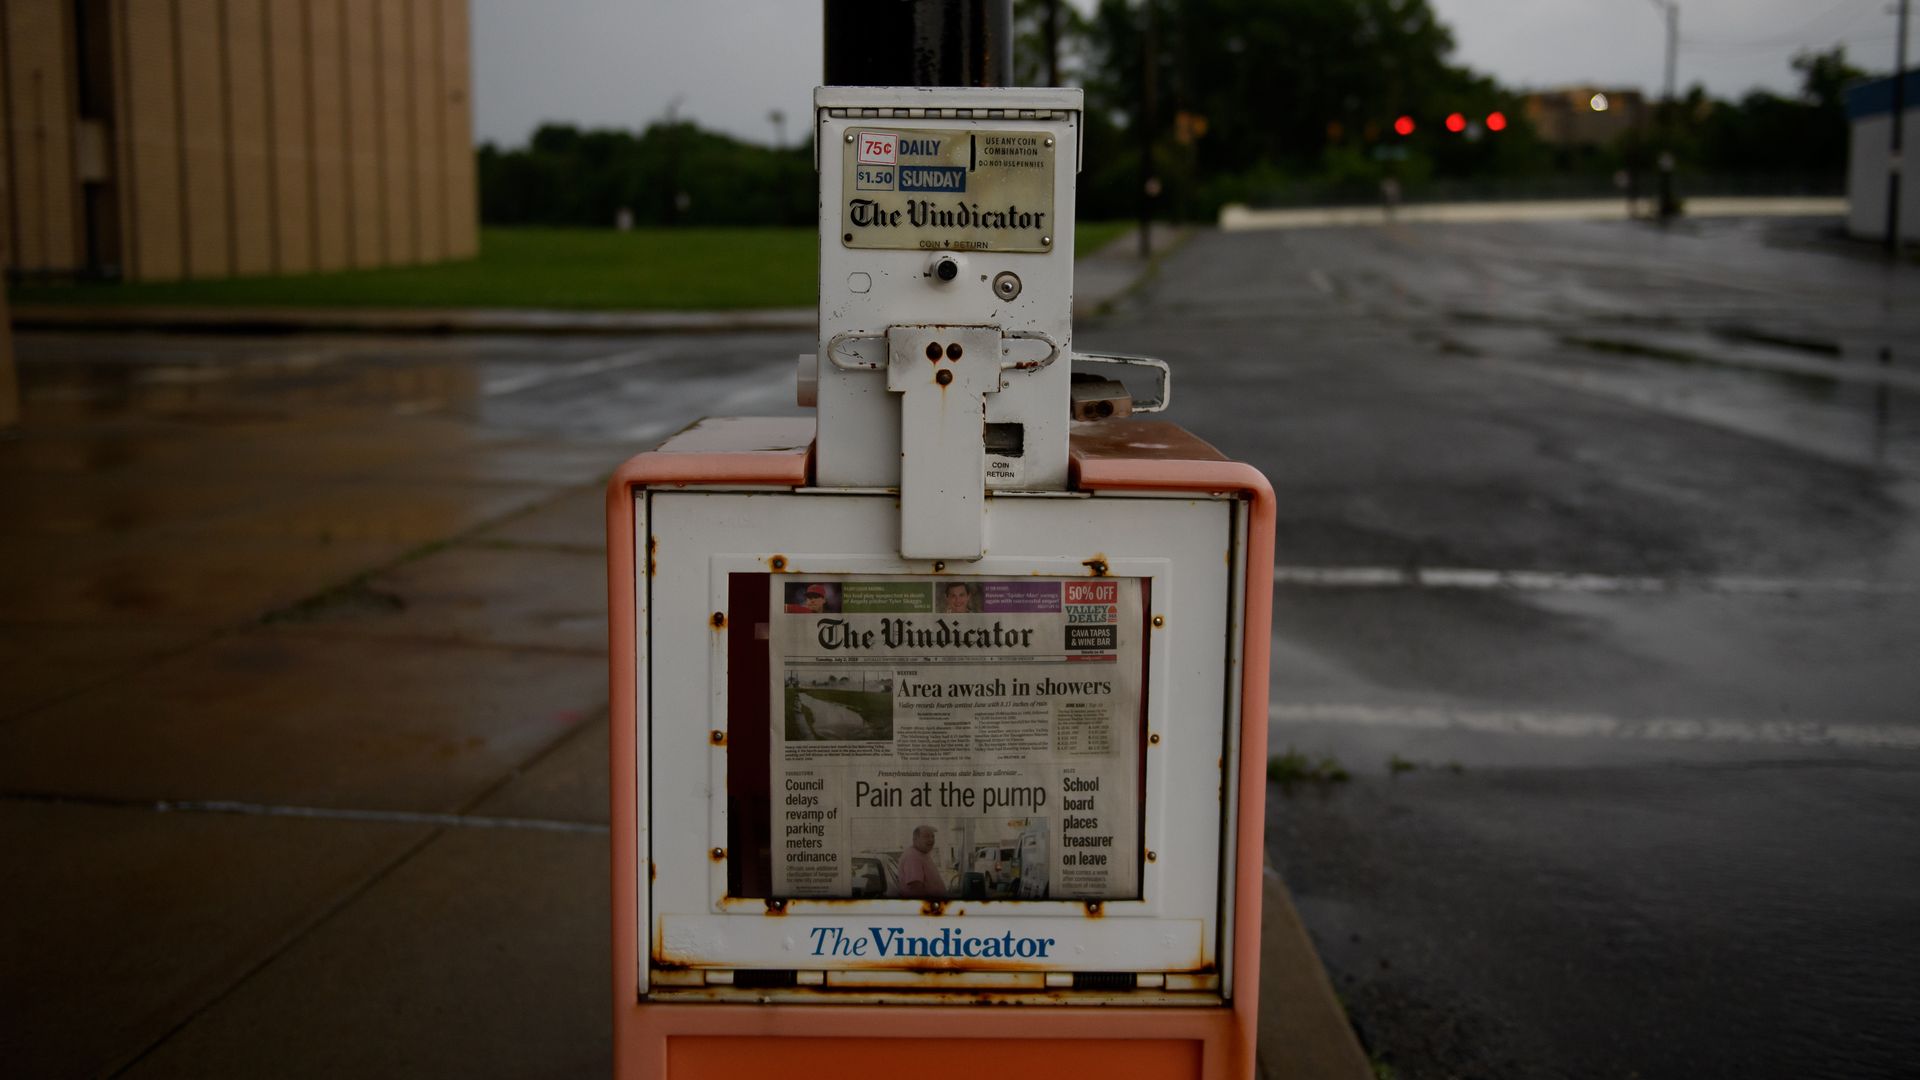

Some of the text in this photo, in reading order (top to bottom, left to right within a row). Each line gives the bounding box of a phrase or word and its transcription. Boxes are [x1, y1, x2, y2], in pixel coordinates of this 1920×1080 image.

[865, 140, 941, 156] 75¢ DAILY
[986, 137, 1037, 146] USE ANY COIN
[984, 147, 1038, 156] COMBINATION
[858, 171, 963, 188] $1.50 SUNDAY
[850, 199, 1045, 230] The Vindicator
[919, 240, 989, 249] COIN RETURN
[991, 461, 1010, 469] COIN
[1069, 586, 1115, 600] 50% OFF
[1065, 605, 1109, 615] VALLEY
[1068, 614, 1107, 624] DEALS
[817, 618, 1034, 650] The Vindicator
[1071, 629, 1111, 637] CAVA TAPAS
[1071, 638, 1111, 646] & WINE BAR
[897, 677, 1112, 698] Area awash in showers
[785, 778, 824, 791] Council
[1063, 777, 1100, 792] School
[785, 793, 819, 807] delays
[856, 781, 1046, 813] Pain at the pump
[1063, 796, 1094, 811] board
[786, 807, 838, 822] revamp of
[786, 823, 825, 837] parking
[1063, 815, 1098, 832] places
[786, 838, 823, 848] meters
[1063, 834, 1114, 848] treasurer
[786, 851, 837, 863] ordinance
[1063, 851, 1107, 865] on leave
